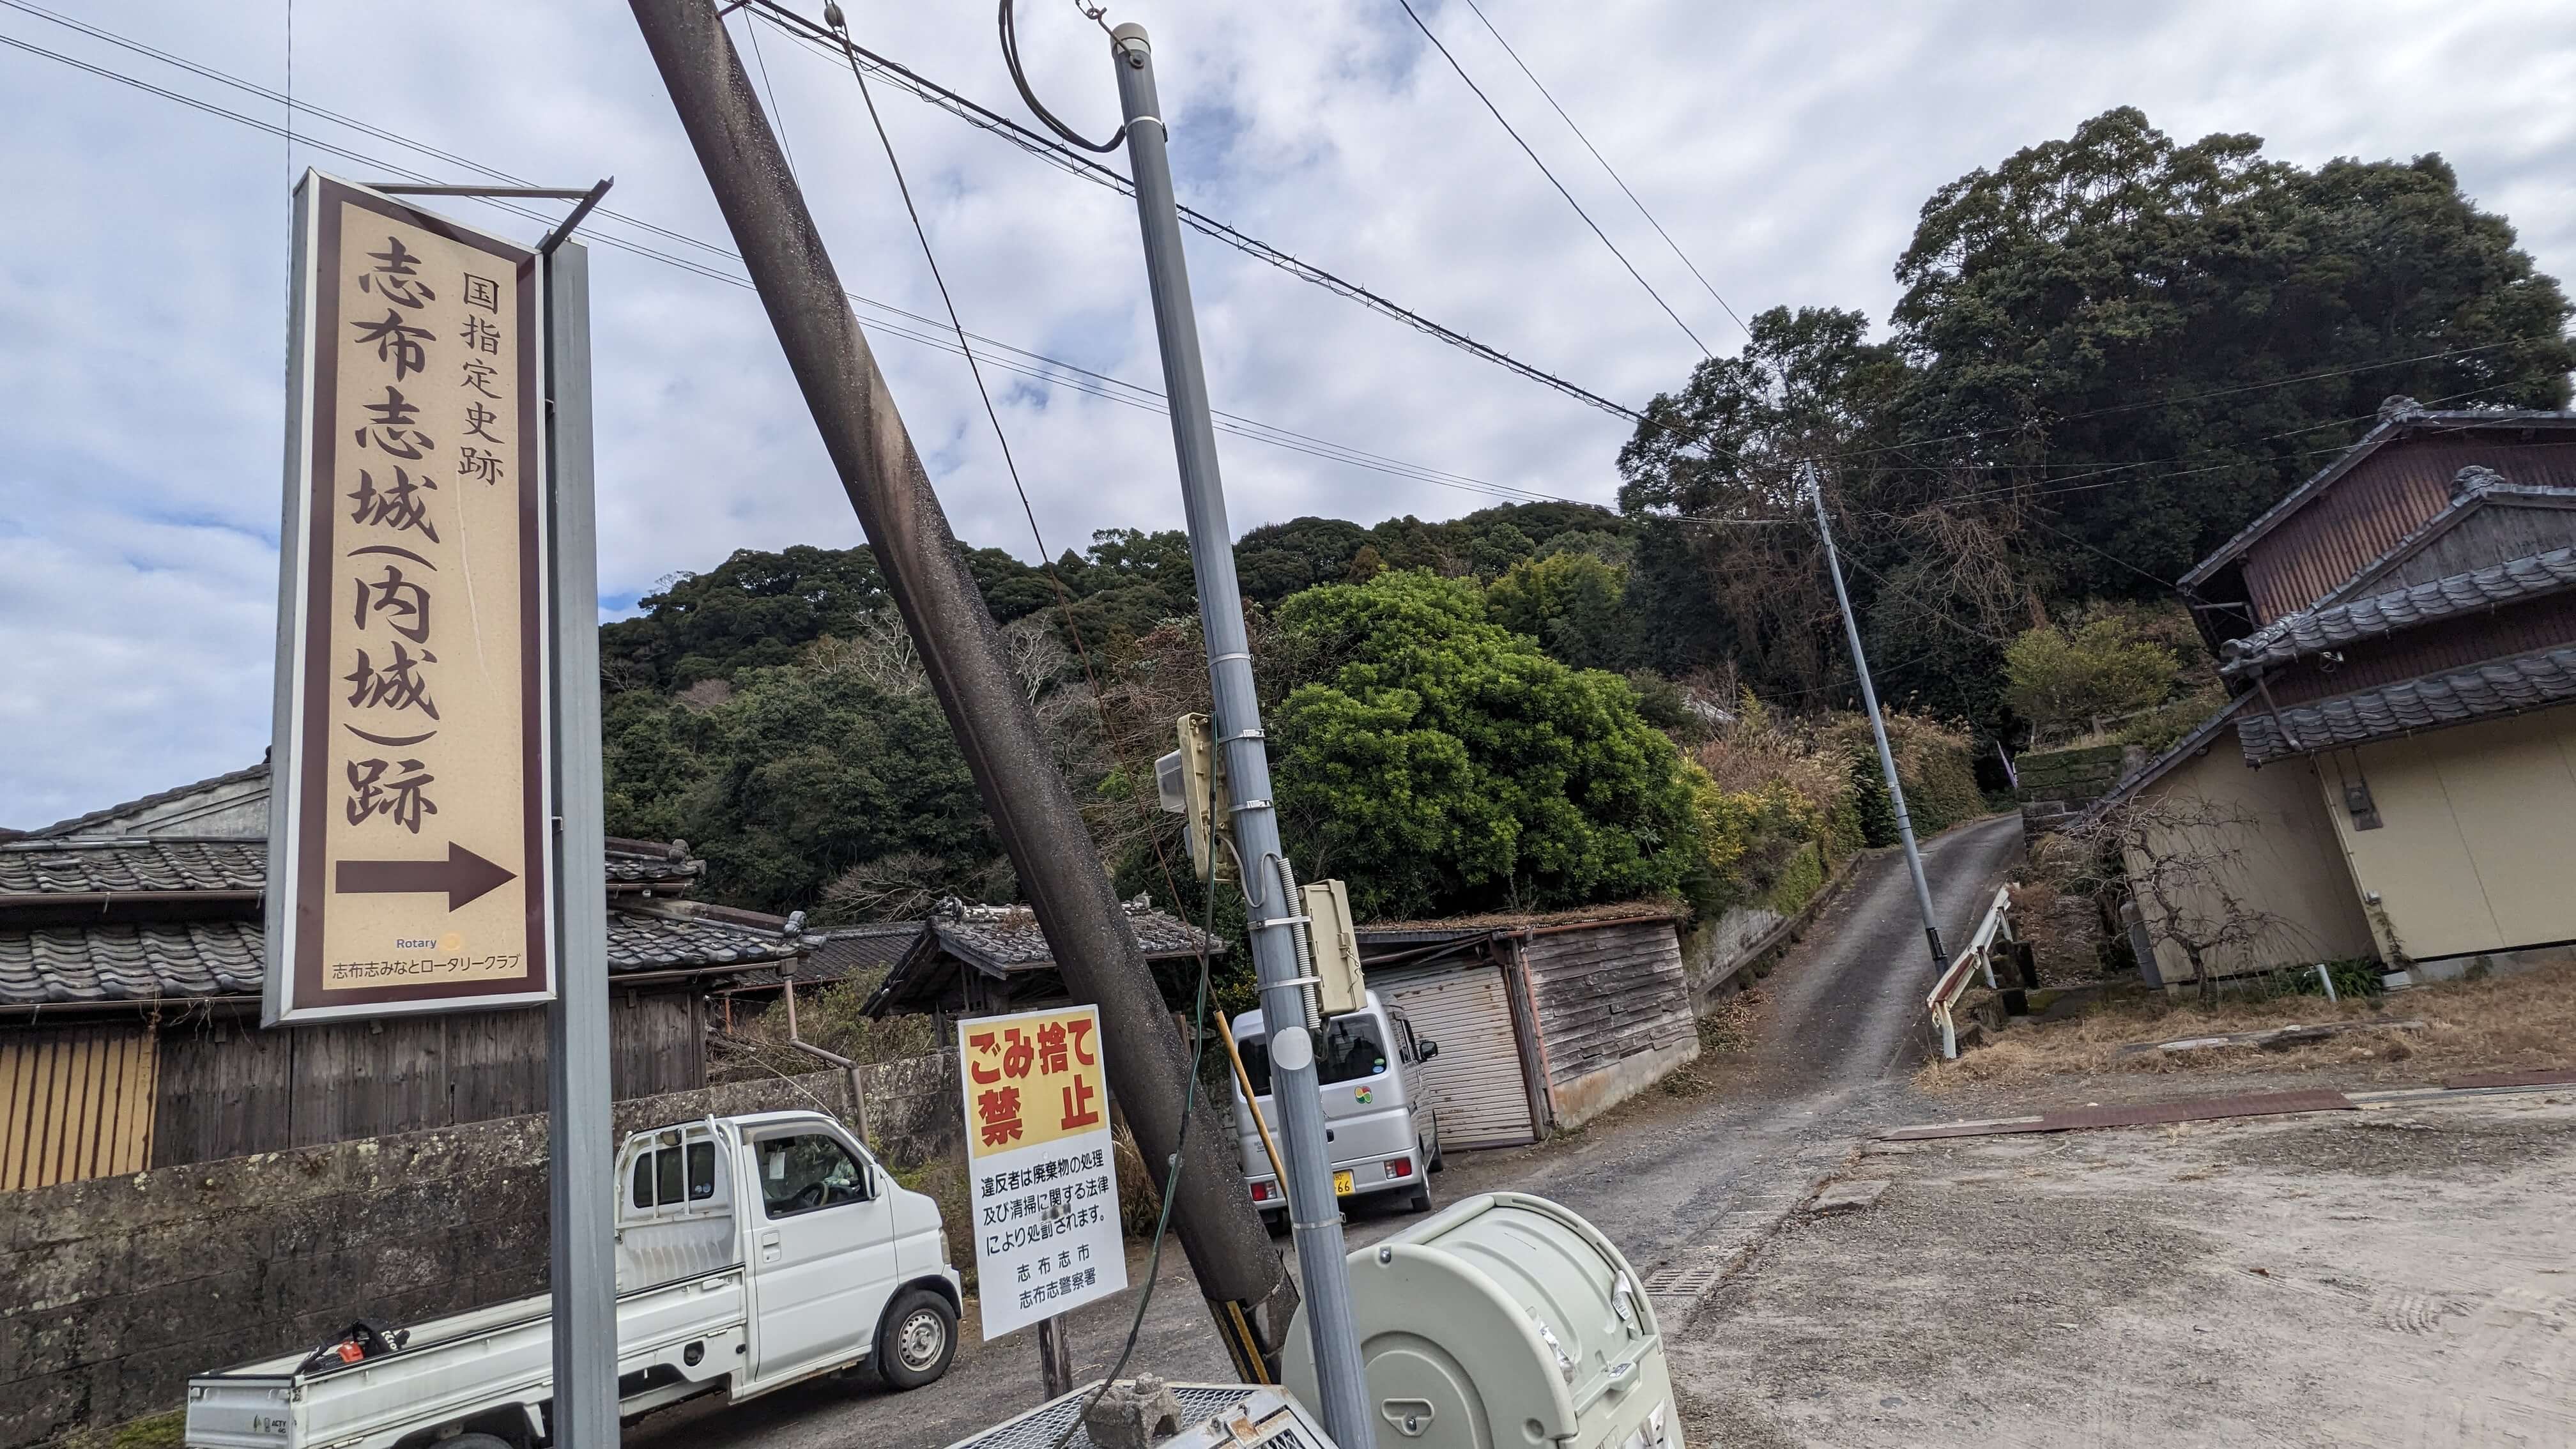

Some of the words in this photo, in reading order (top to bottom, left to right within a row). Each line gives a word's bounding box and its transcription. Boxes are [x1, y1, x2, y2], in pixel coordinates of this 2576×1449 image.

[457, 272, 505, 486] 国指定史跡
[332, 953, 521, 979] 志布志みなとロータリークラブ
[396, 938, 437, 949] Rotary
[969, 1018, 1094, 1084] ごみ捨て
[981, 1149, 1104, 1199] 違反者は廃棄物の処理
[983, 1175, 1110, 1226] 及び清掃に関する法律
[1019, 1267, 1096, 1310] 志布志警察署
